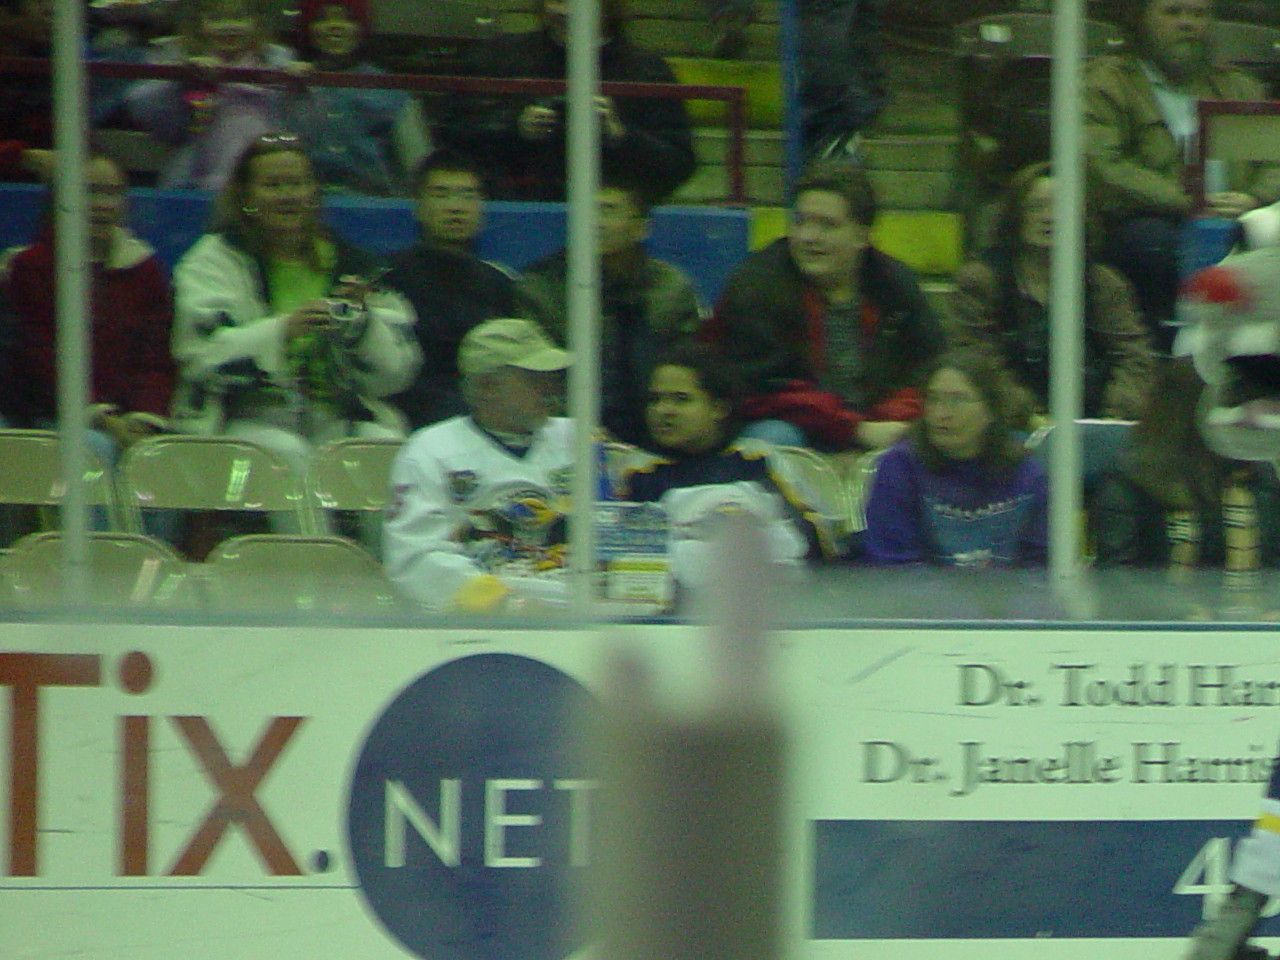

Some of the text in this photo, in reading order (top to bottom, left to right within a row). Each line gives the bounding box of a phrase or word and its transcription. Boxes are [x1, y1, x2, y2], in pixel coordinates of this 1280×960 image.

[956, 663, 1041, 706] Dr.
[1050, 663, 1179, 707] Todd
[859, 740, 948, 784] Dr.
[950, 741, 1122, 797] Janelle
[383, 777, 604, 869] NET
